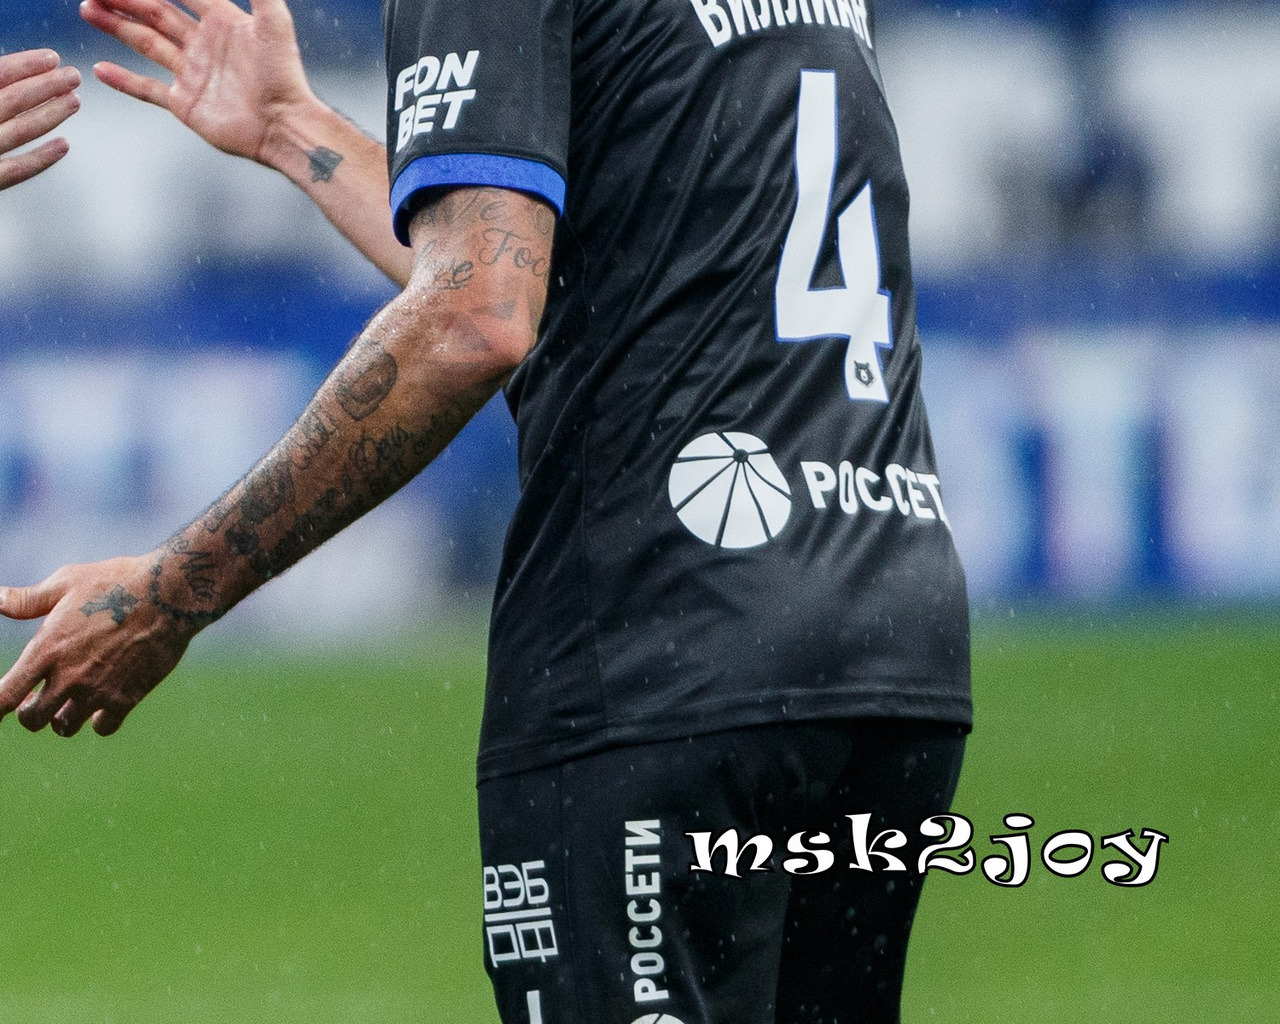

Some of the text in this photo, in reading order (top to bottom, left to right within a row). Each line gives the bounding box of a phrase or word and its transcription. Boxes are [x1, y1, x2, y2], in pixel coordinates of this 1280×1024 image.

[394, 49, 480, 111] FON
[396, 89, 477, 153] BET
[775, 68, 894, 404] 4
[483, 859, 550, 910] ВЭБ
[624, 819, 669, 1002] РОССЕТИ
[486, 919, 559, 968] РФ
